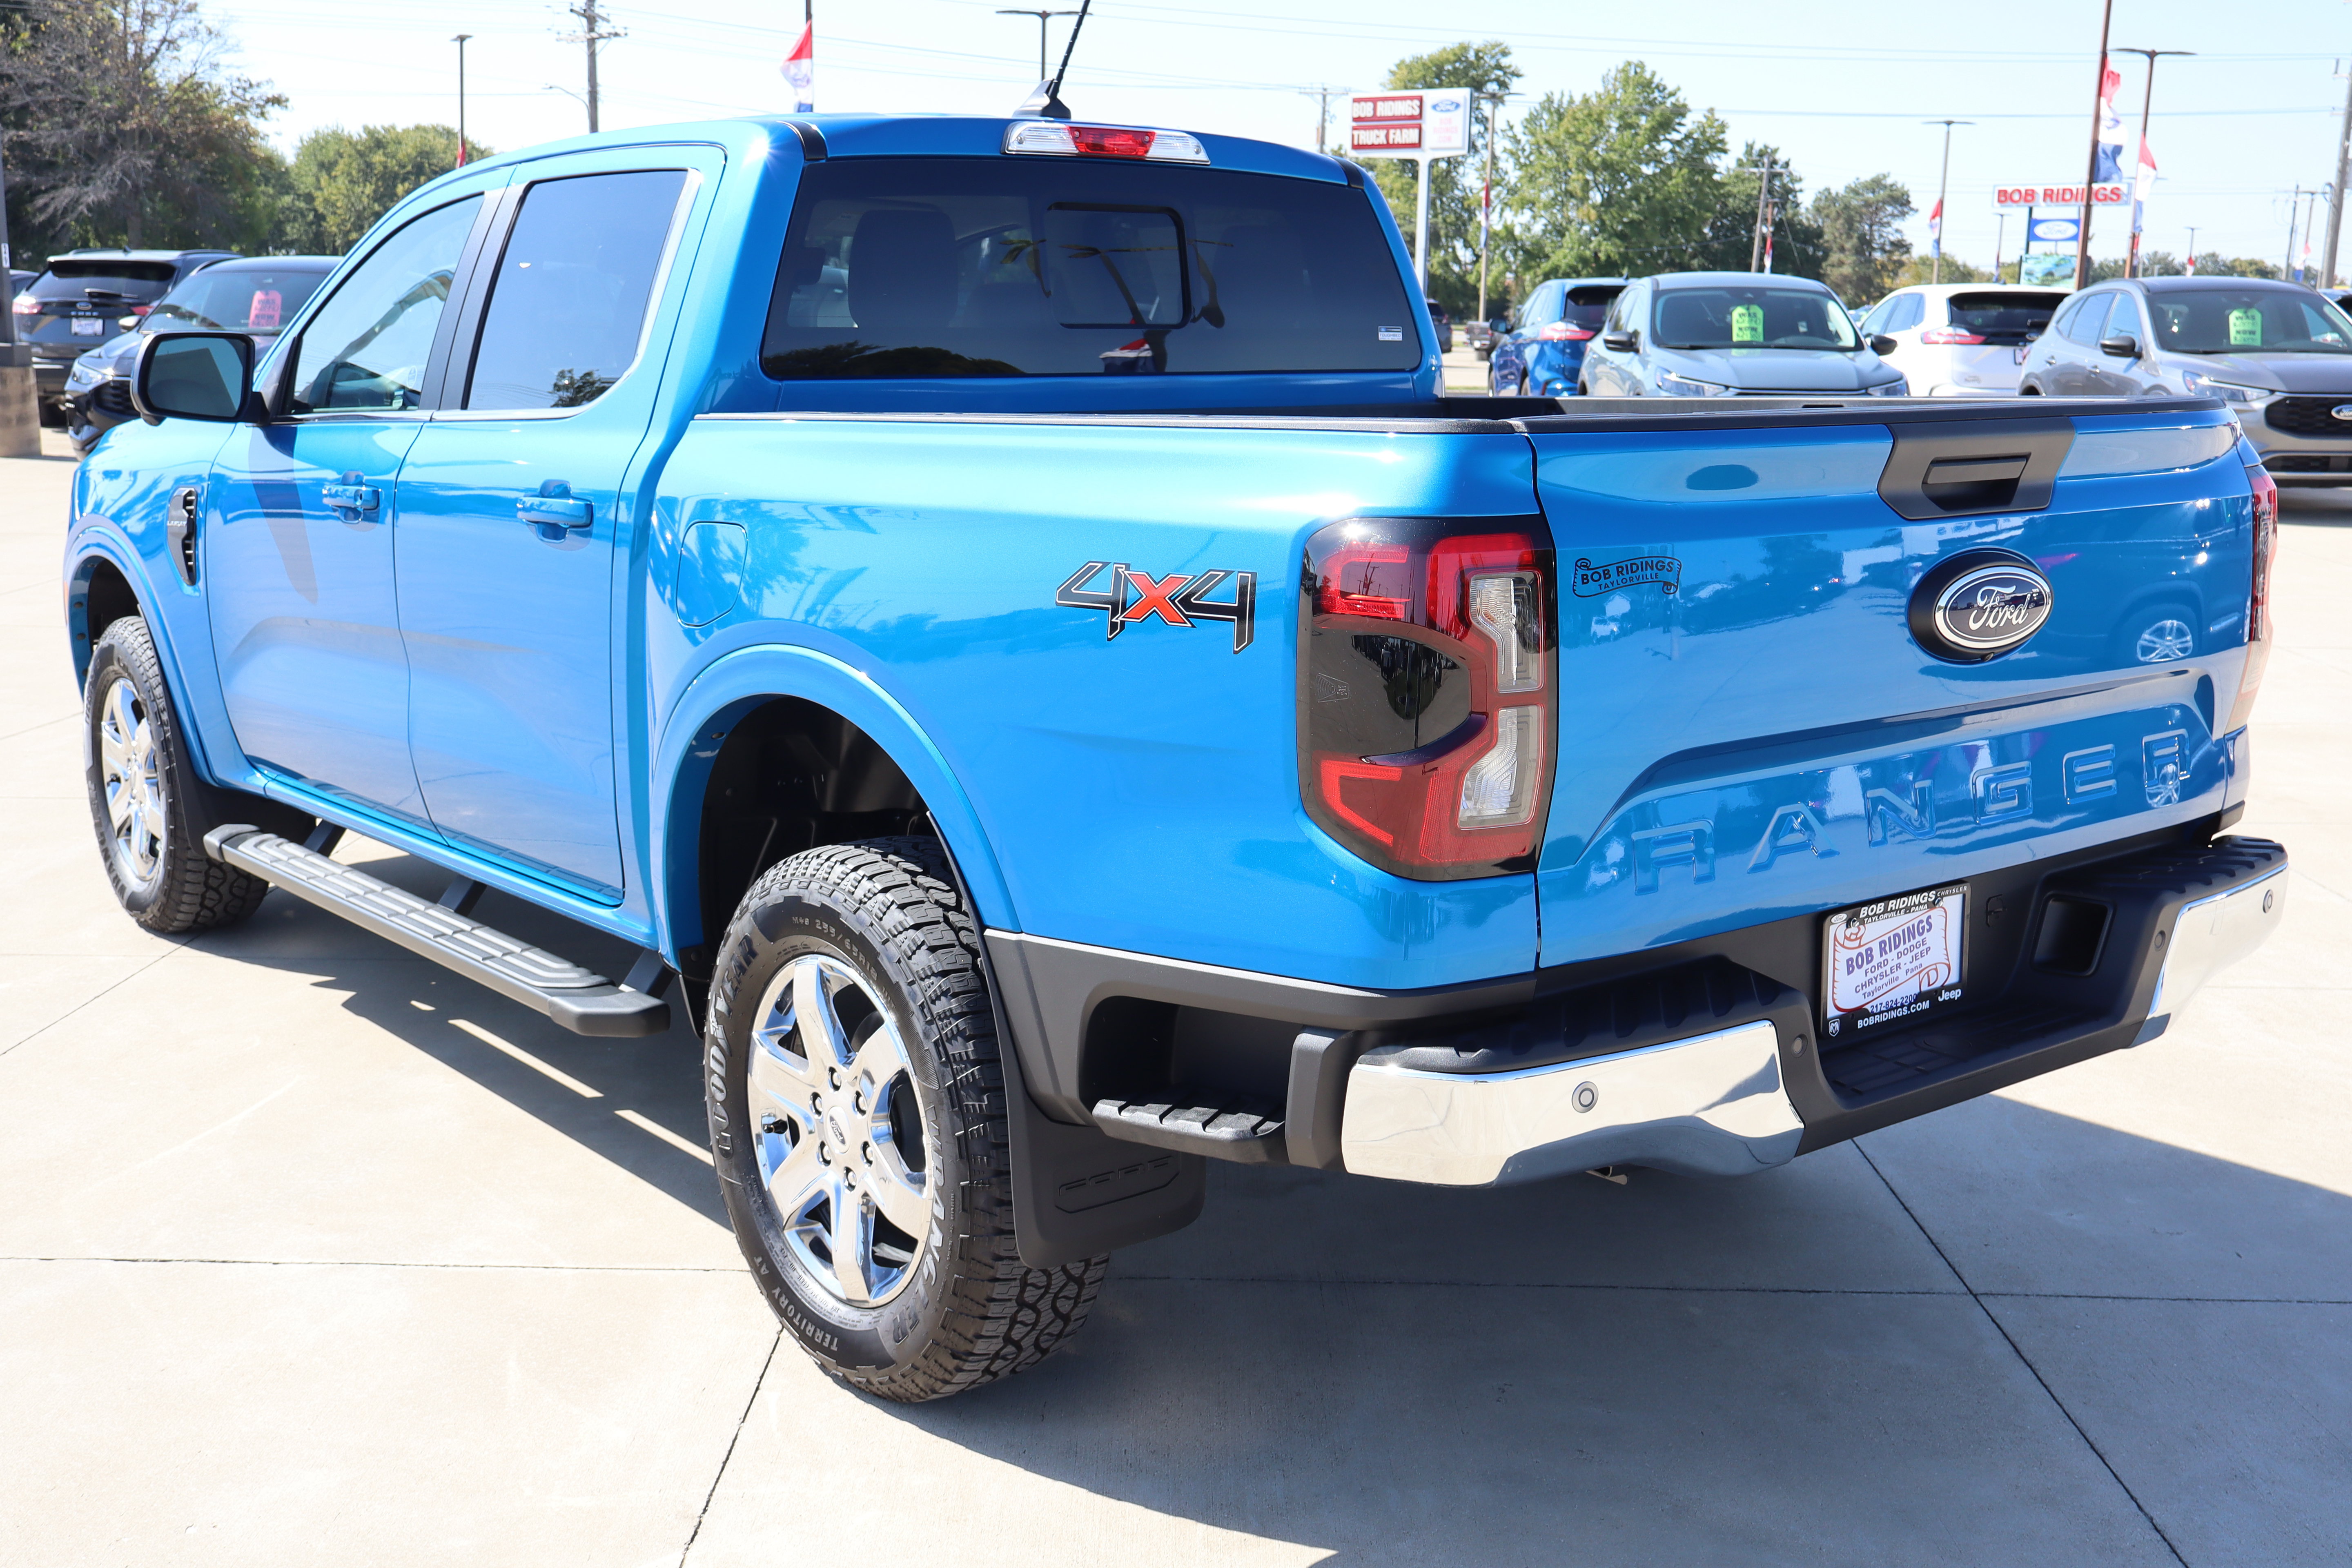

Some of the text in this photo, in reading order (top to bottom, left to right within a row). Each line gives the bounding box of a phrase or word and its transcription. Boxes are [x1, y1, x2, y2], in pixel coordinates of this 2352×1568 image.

[1352, 100, 1420, 118] BOB RIDINGS
[1352, 128, 1419, 145] TRUCK FARM
[1998, 189, 2036, 203] BOB
[1581, 559, 1674, 585] BOB RIDINGS
[1598, 572, 1659, 590] TAYLORVILLE
[1969, 585, 2031, 630] Ford
[1632, 728, 2191, 896] RANGER
[1860, 890, 1936, 918] BOB RIDINGS
[1937, 885, 1967, 896] CHRYSLER
[1864, 909, 1905, 924] TAYLORVILLE
[1910, 904, 1928, 913] PANA
[1846, 914, 1933, 976] BOB RIDINGS
[1864, 958, 1889, 978] FORD
[1897, 937, 1927, 960] DODGE
[1855, 962, 1902, 993] CHRYSLER
[1909, 946, 1931, 964] JEEP
[1862, 963, 1923, 1000] Taylorville Pana
[1938, 988, 1962, 1002] Jeep
[1858, 1000, 1930, 1029] BOBRIDINGS.COM
[706, 933, 759, 1159] GOODYEAR
[892, 1102, 945, 1344] WRANGLER
[754, 1256, 769, 1275] AT
[771, 1286, 839, 1351] TERRITORY
